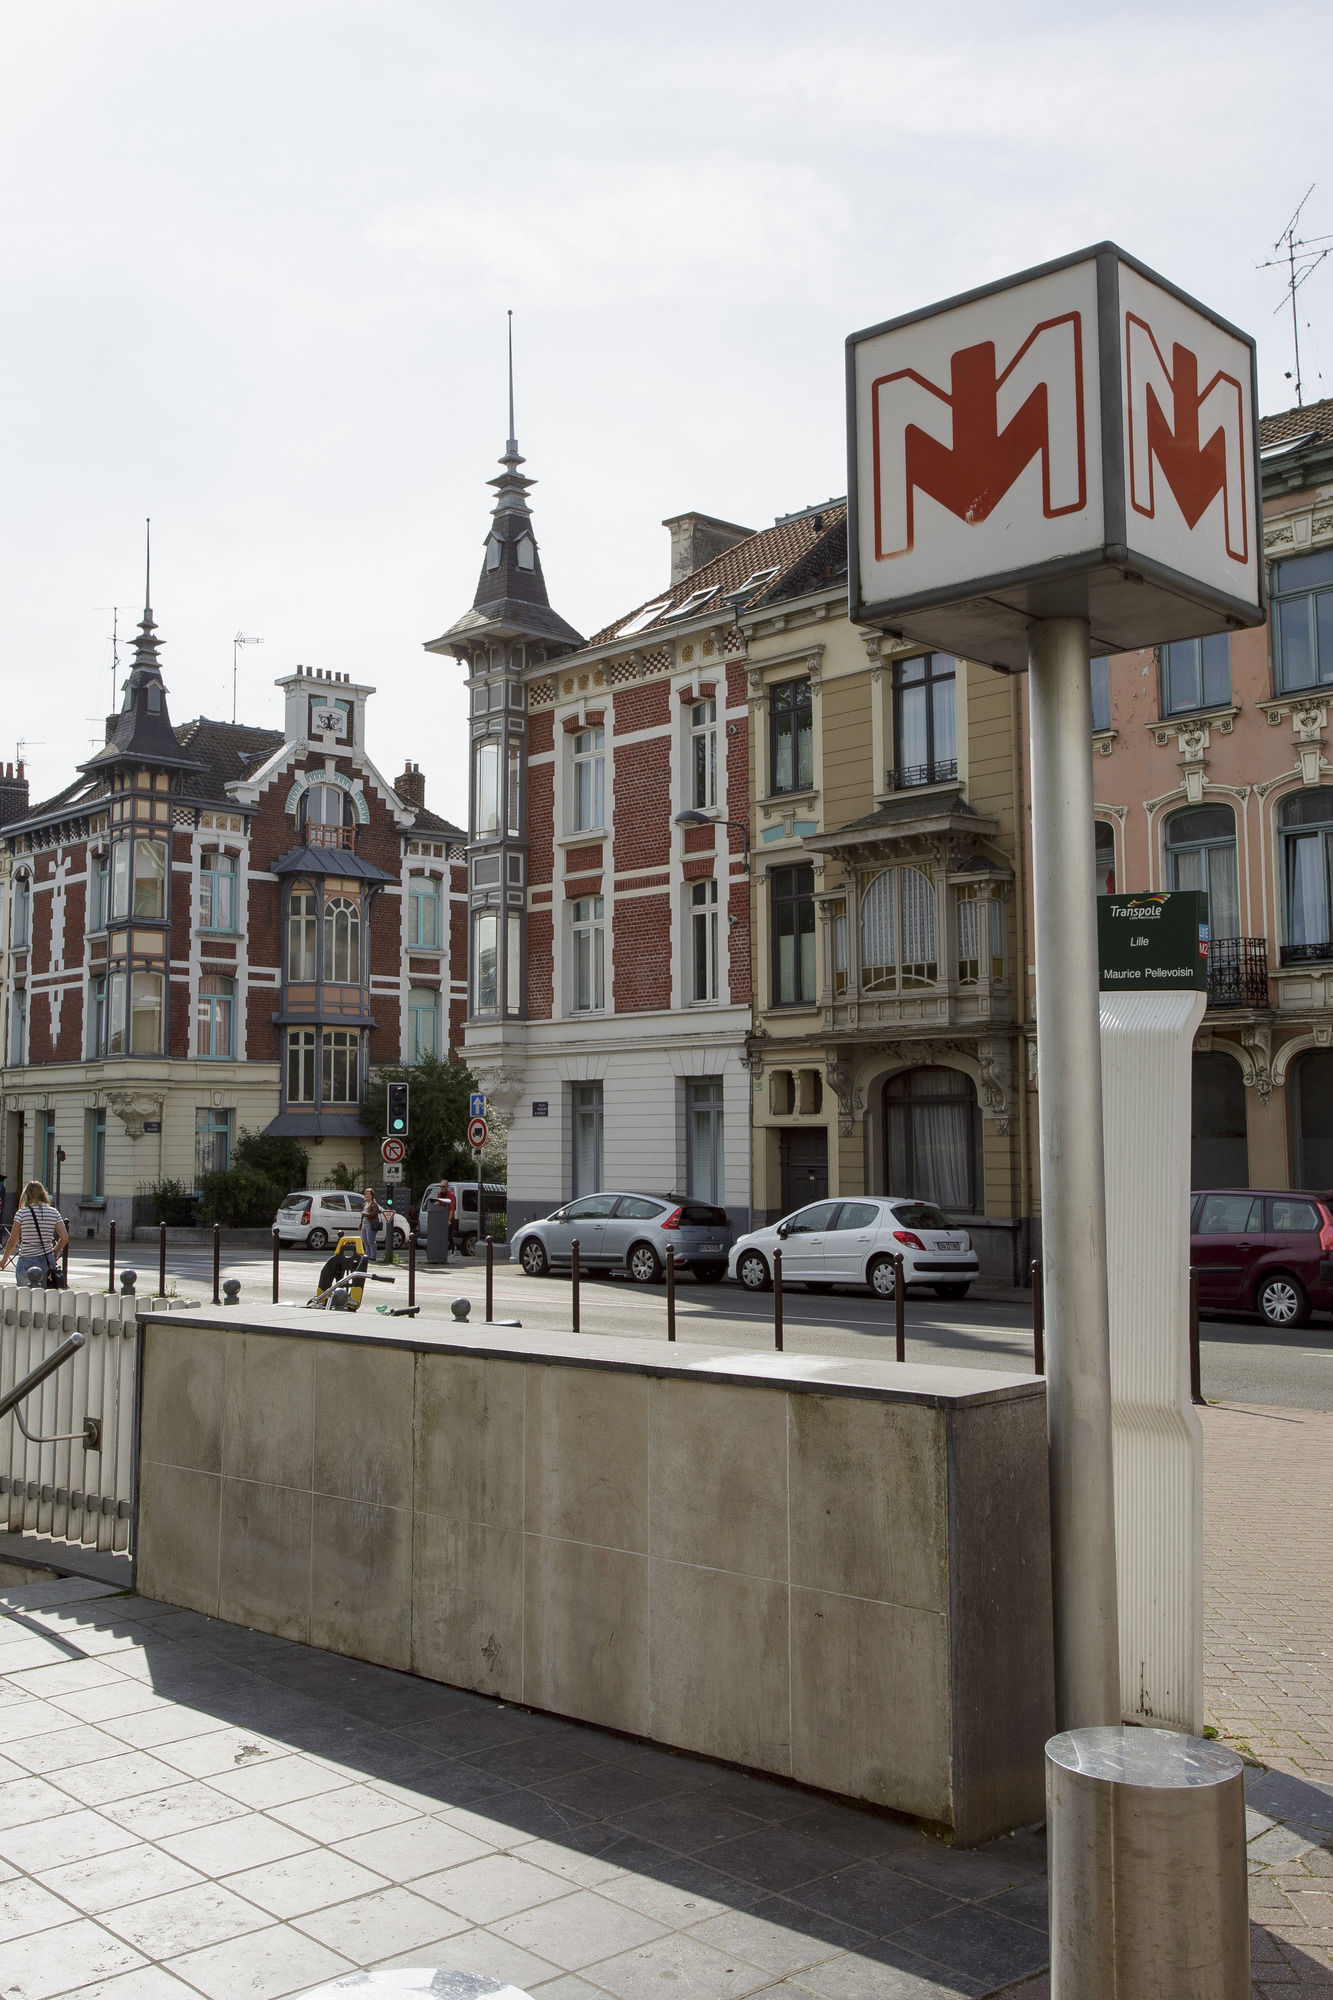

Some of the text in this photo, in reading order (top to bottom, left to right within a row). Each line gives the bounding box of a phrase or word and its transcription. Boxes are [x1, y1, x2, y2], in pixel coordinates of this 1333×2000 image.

[1110, 905, 1162, 918] Transpole
[1130, 937, 1149, 947] Lille
[1104, 967, 1194, 979] Maurice Pellevoisin
